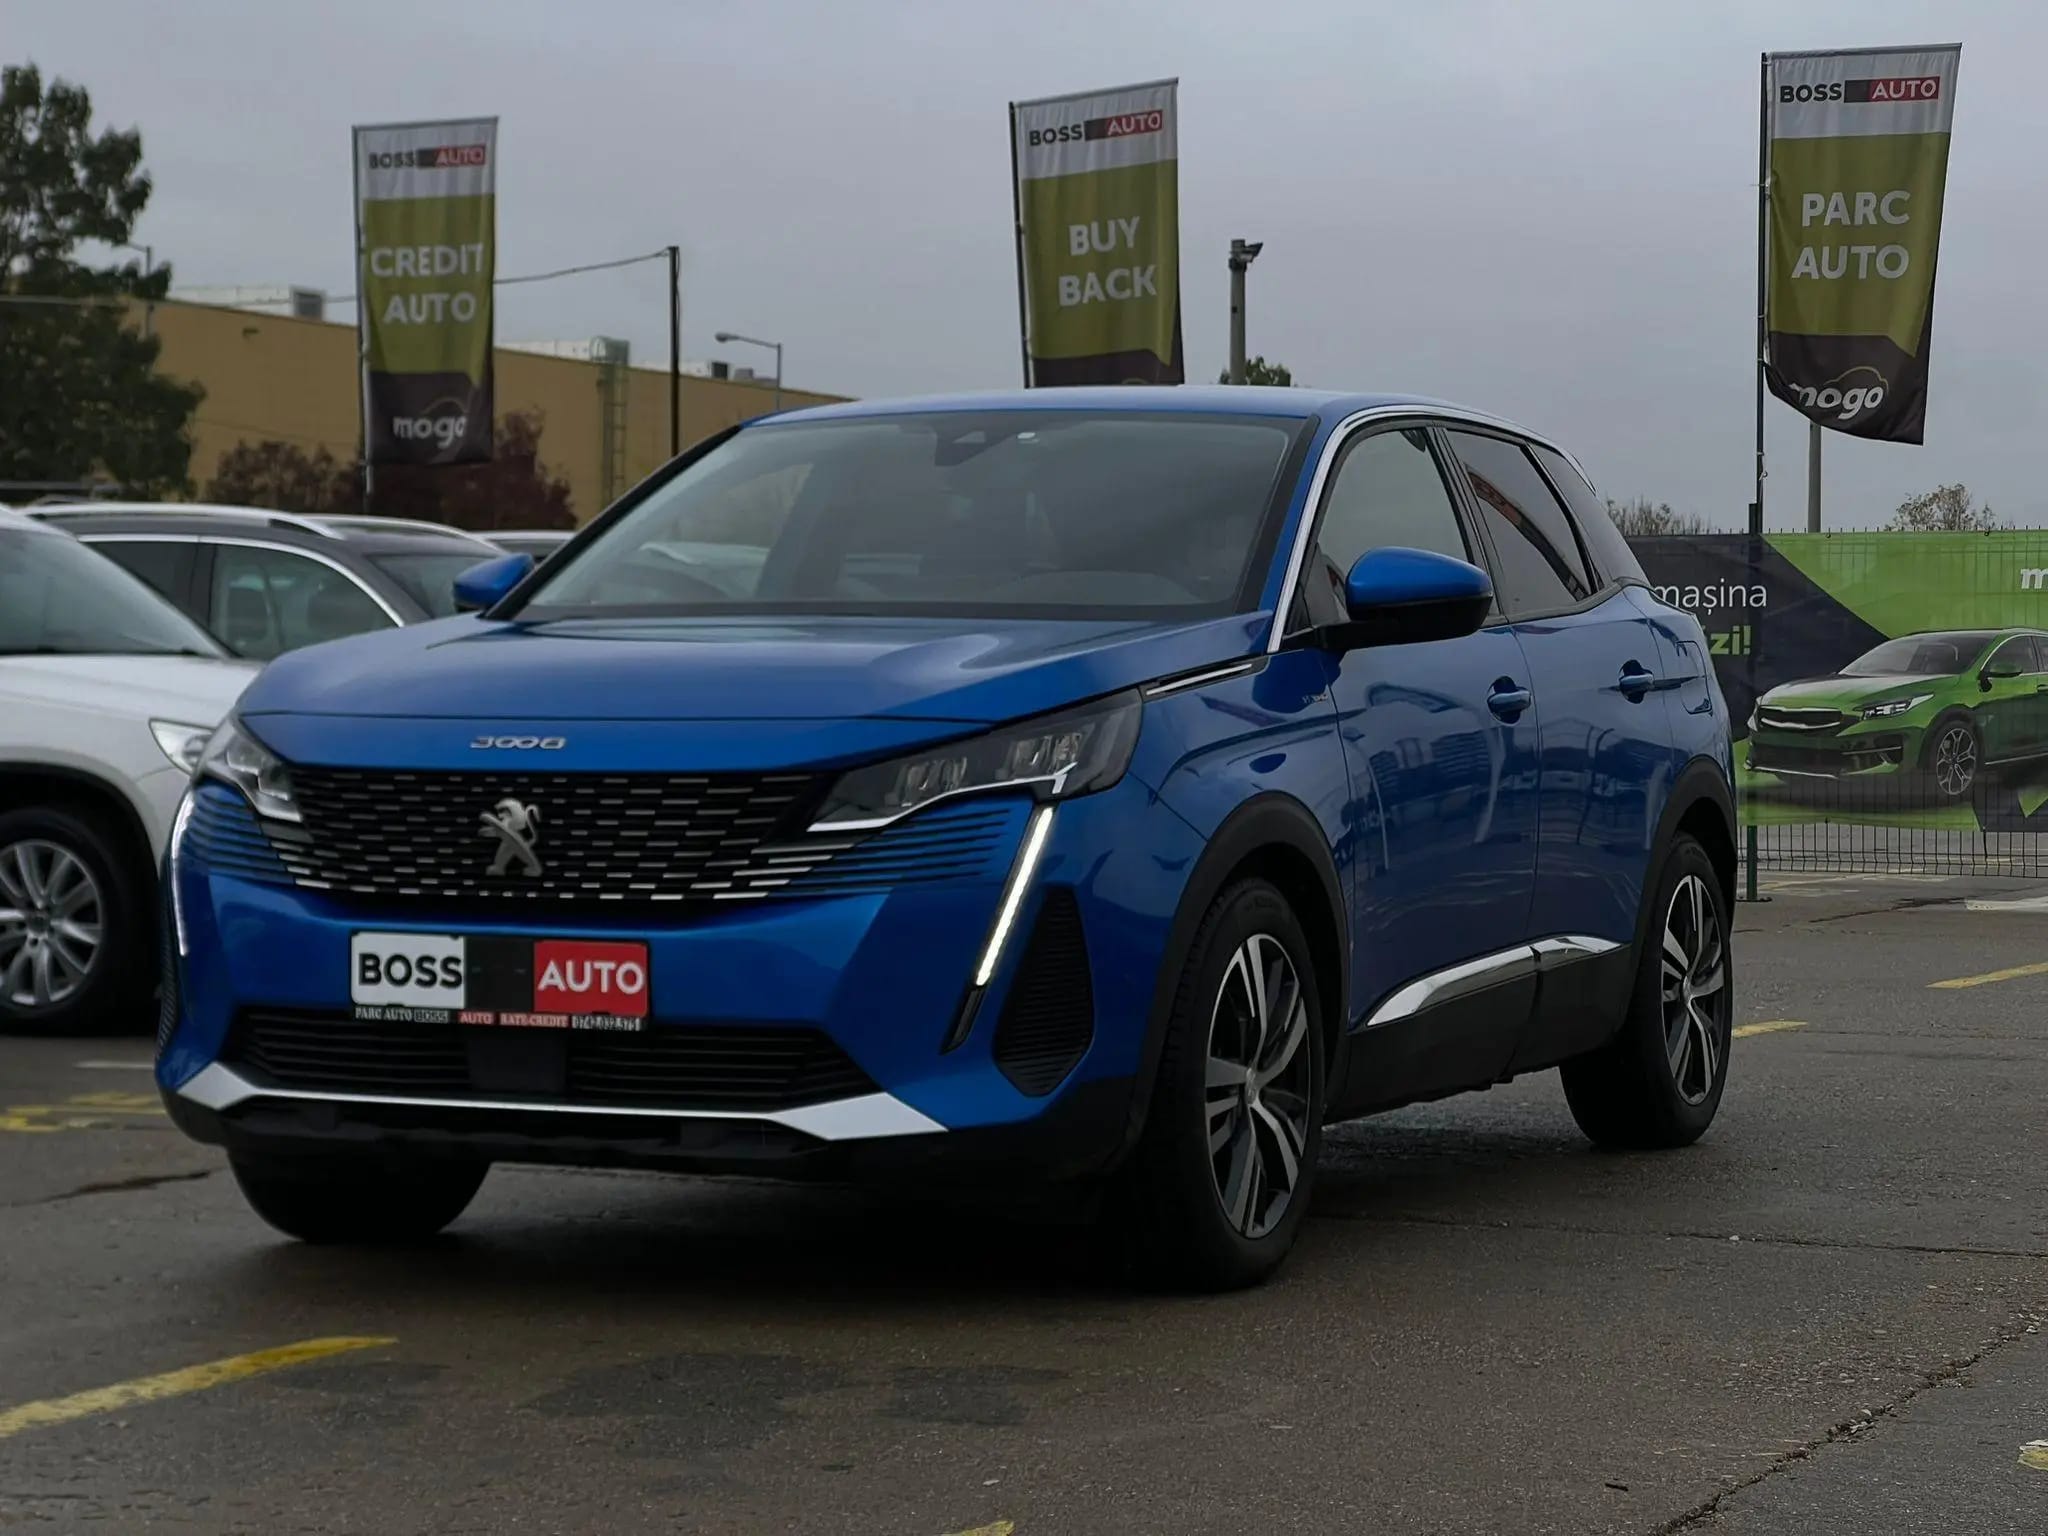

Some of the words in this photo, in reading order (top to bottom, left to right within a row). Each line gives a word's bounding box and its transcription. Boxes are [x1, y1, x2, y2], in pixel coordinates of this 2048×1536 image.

[1778, 82, 1842, 104] BOSS
[1871, 78, 1937, 100] AUTO
[1028, 123, 1083, 147] BOSS
[1106, 110, 1161, 136] AUTO
[368, 150, 416, 169] BOSS
[436, 144, 485, 167] AUTO
[1801, 190, 1911, 228] PARC
[1069, 216, 1140, 257] BUY
[370, 242, 484, 278] CREDIT
[1791, 243, 1910, 281] AUTO
[1058, 264, 1158, 308] BACK
[383, 291, 477, 325] AUTO
[1700, 625, 1752, 655] zi!
[358, 952, 463, 988] BOSS
[537, 960, 645, 995] AUTO
[384, 1008, 412, 1022] AUTO
